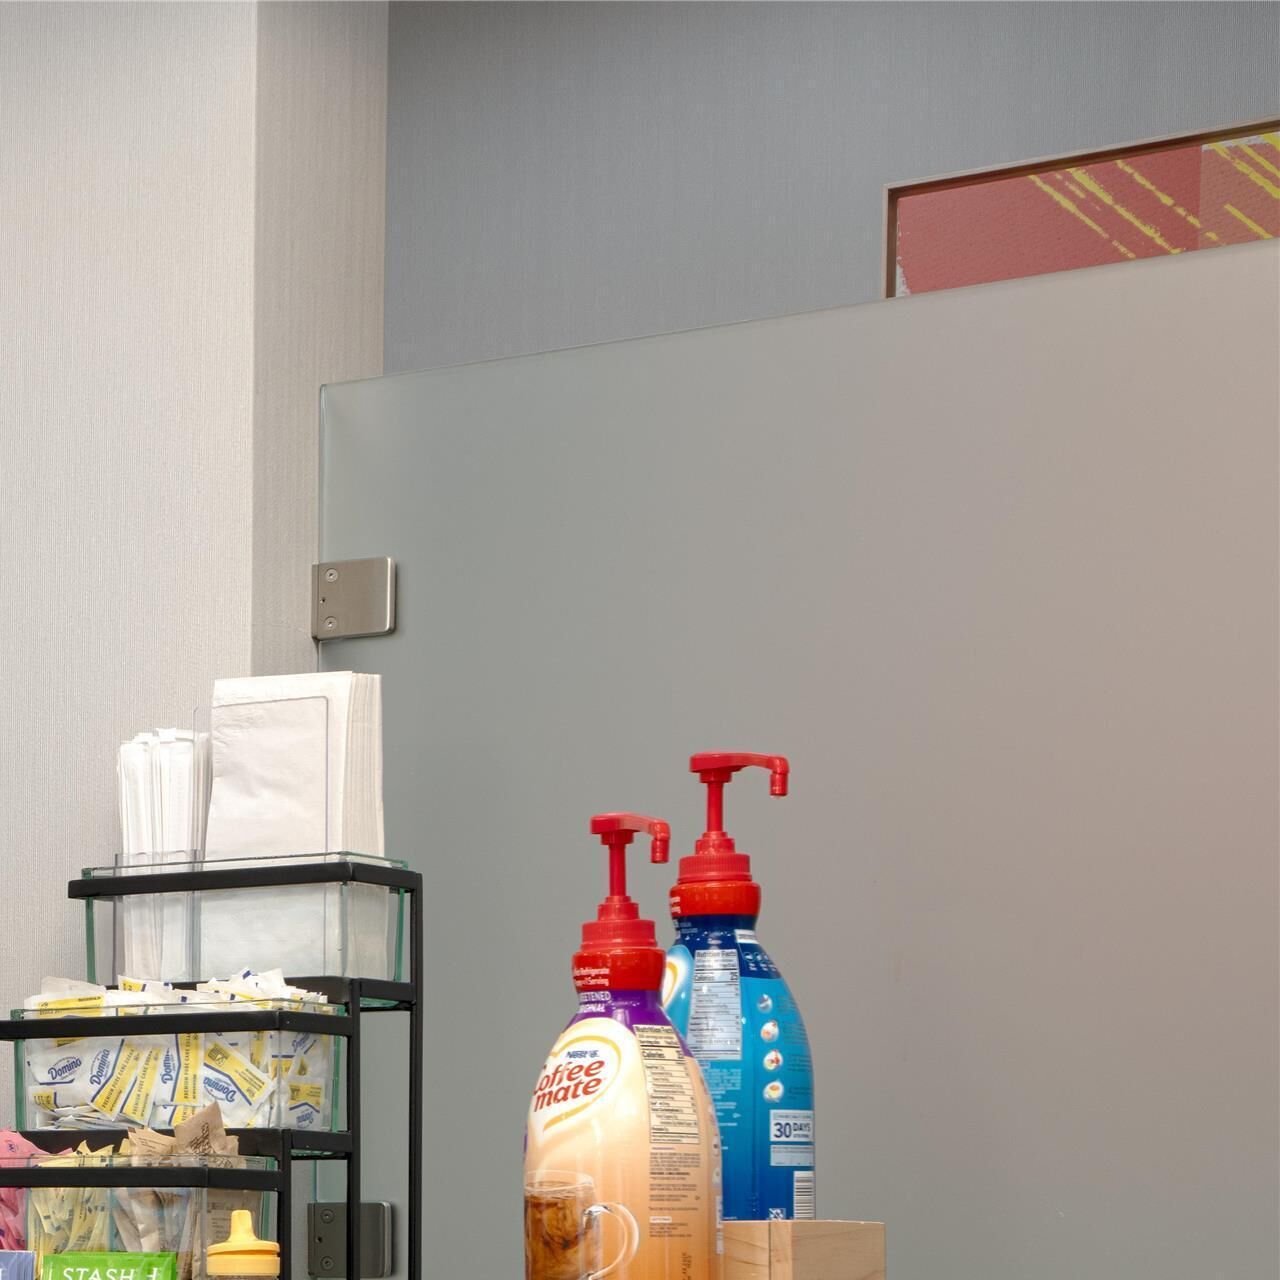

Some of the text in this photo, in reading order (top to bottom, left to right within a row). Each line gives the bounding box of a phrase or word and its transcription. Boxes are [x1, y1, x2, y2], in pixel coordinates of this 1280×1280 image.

[48, 1056, 82, 1080] Domino
[90, 1048, 110, 1086] Domino
[203, 1076, 237, 1102] Domino
[534, 1078, 602, 1113] mate
[773, 1122, 792, 1139] 30
